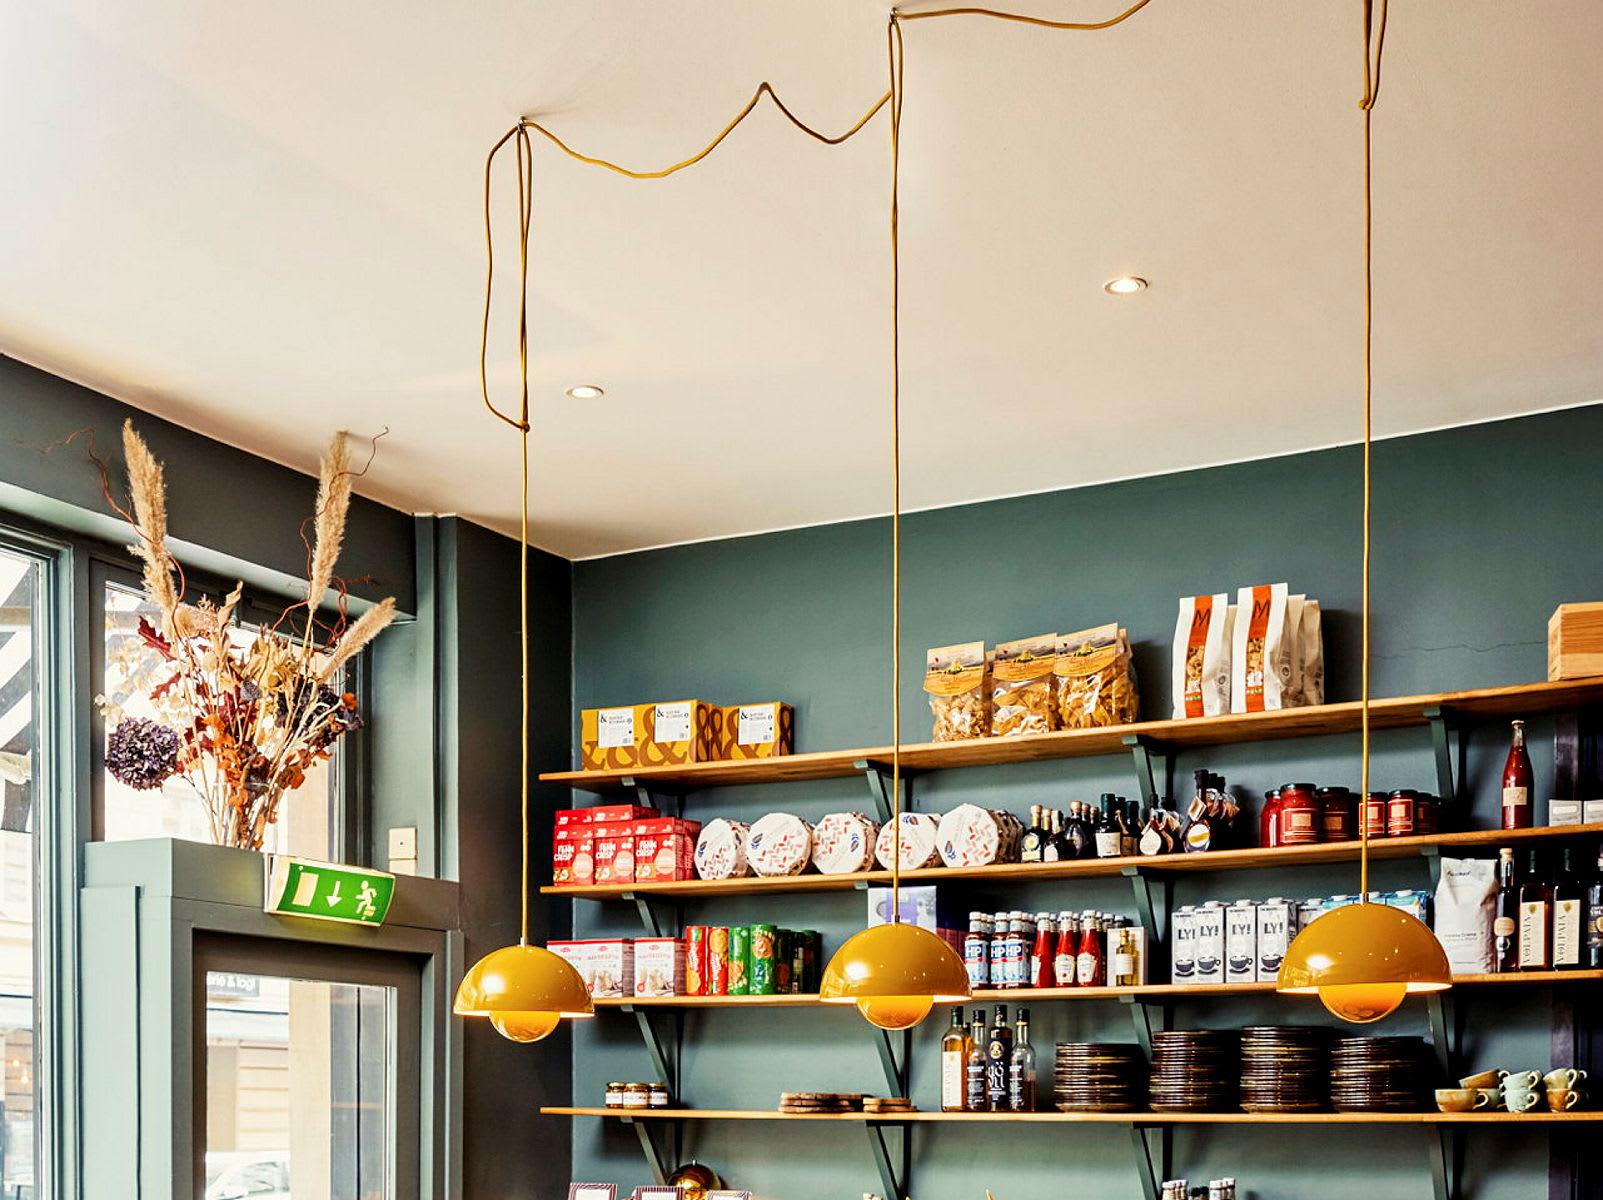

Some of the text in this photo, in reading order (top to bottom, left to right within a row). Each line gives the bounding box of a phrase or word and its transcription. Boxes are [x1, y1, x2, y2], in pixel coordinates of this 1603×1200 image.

[1252, 600, 1270, 618] M
[1192, 608, 1211, 627] M
[1200, 925, 1219, 937] LY!
[1232, 924, 1251, 935] LY!
[1264, 922, 1283, 934] LY!
[966, 946, 982, 958] HP
[991, 946, 1005, 958] HP
[1006, 945, 1022, 956] HP
